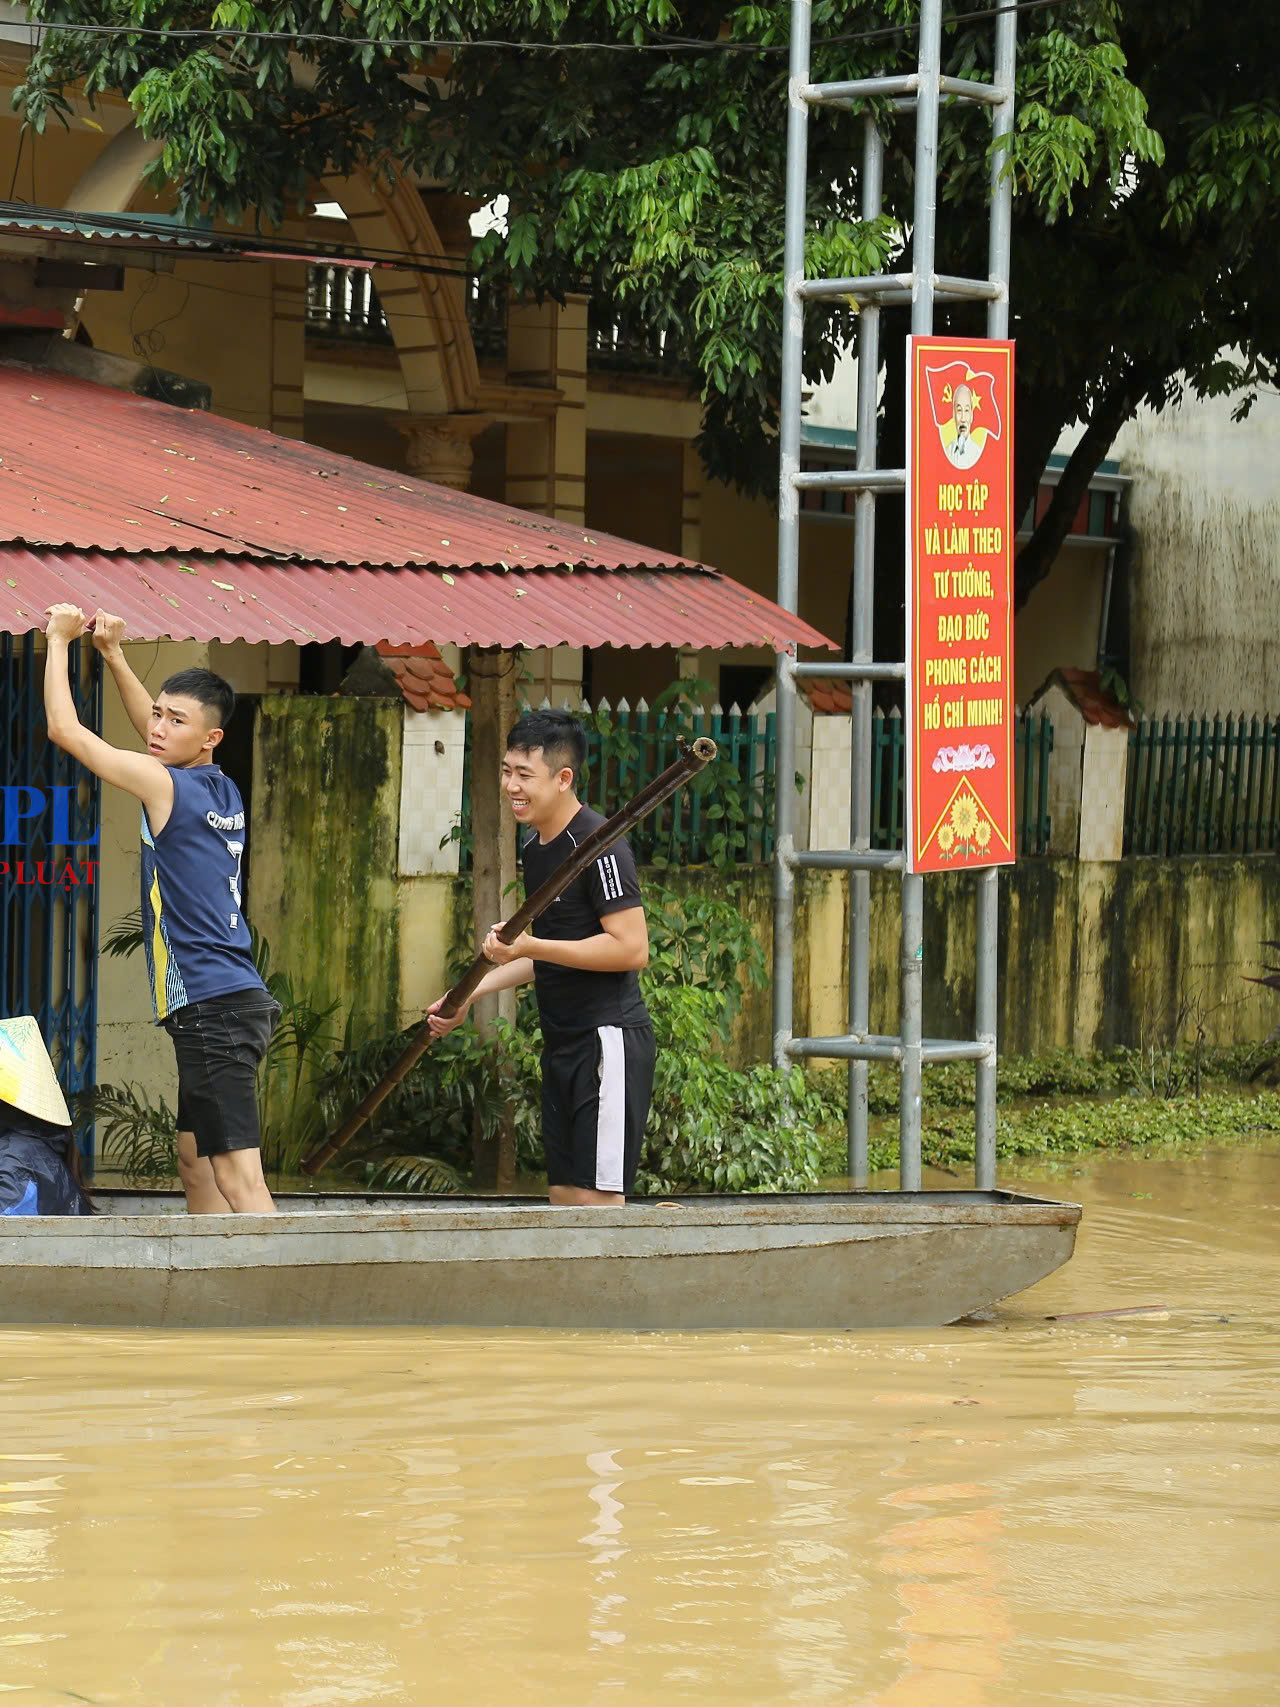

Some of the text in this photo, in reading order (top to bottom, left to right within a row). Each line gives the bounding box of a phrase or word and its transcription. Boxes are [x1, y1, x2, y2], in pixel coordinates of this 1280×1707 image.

[938, 479, 989, 518] HỌC TẬP
[924, 523, 1002, 556] VÀ LÀM THEO
[933, 562, 995, 601] TƯ TƯỞNG,
[937, 608, 990, 648] ĐẠO ĐỨC
[925, 651, 1002, 687] PHONG CÁCH
[923, 692, 1003, 731] HỒ CHÍ MINH!
